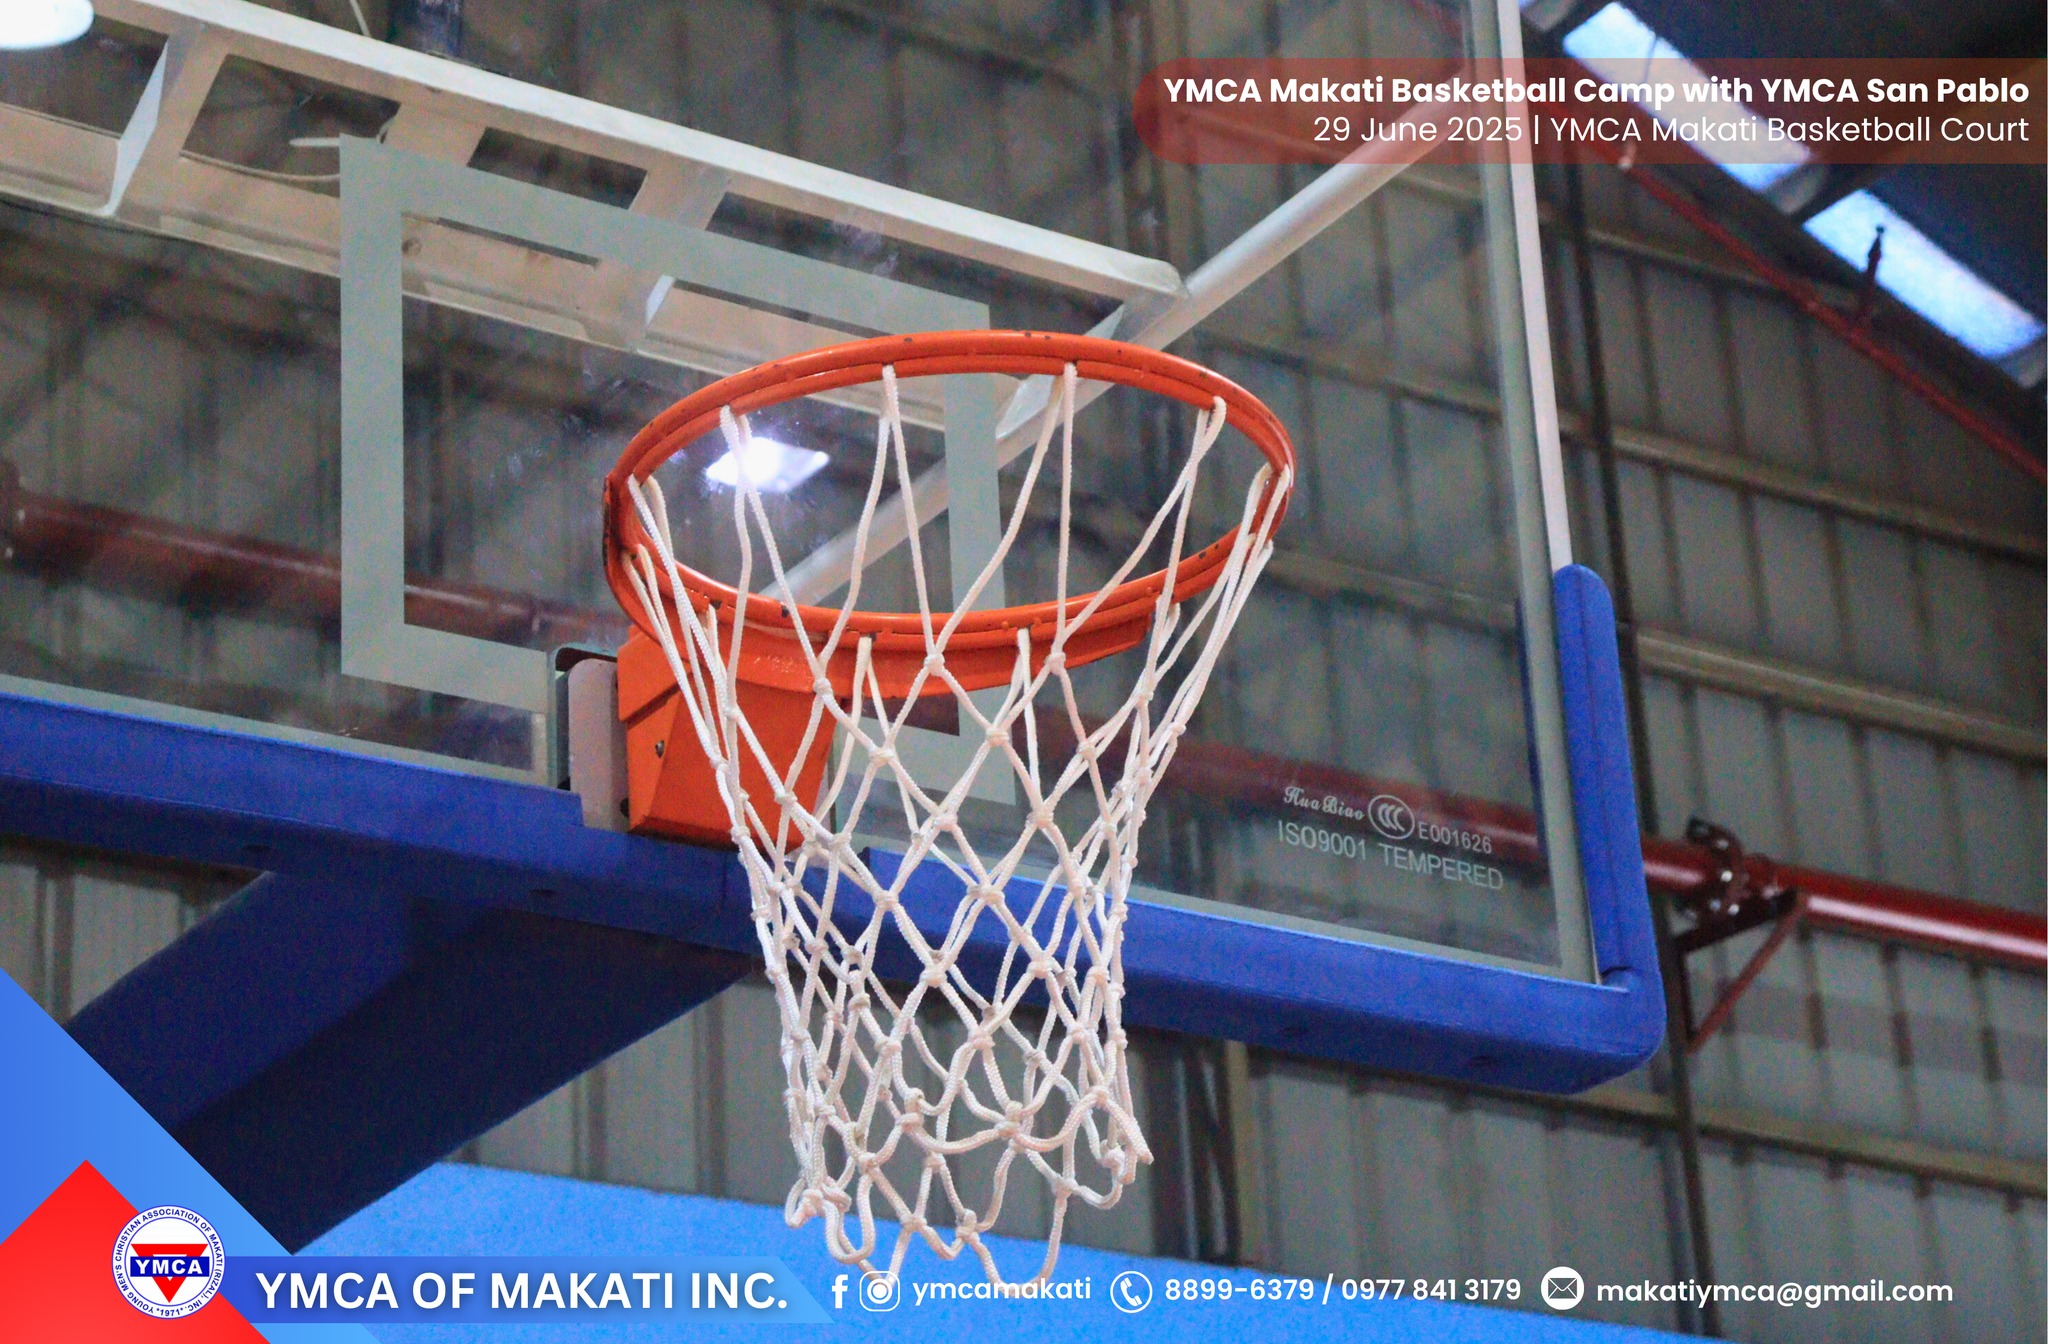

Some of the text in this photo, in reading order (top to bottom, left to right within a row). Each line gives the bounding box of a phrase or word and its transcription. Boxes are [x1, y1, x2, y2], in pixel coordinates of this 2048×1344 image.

[1278, 820, 1504, 890] ISO9001 TEMPERED
[1418, 821, 1493, 855] E001626
